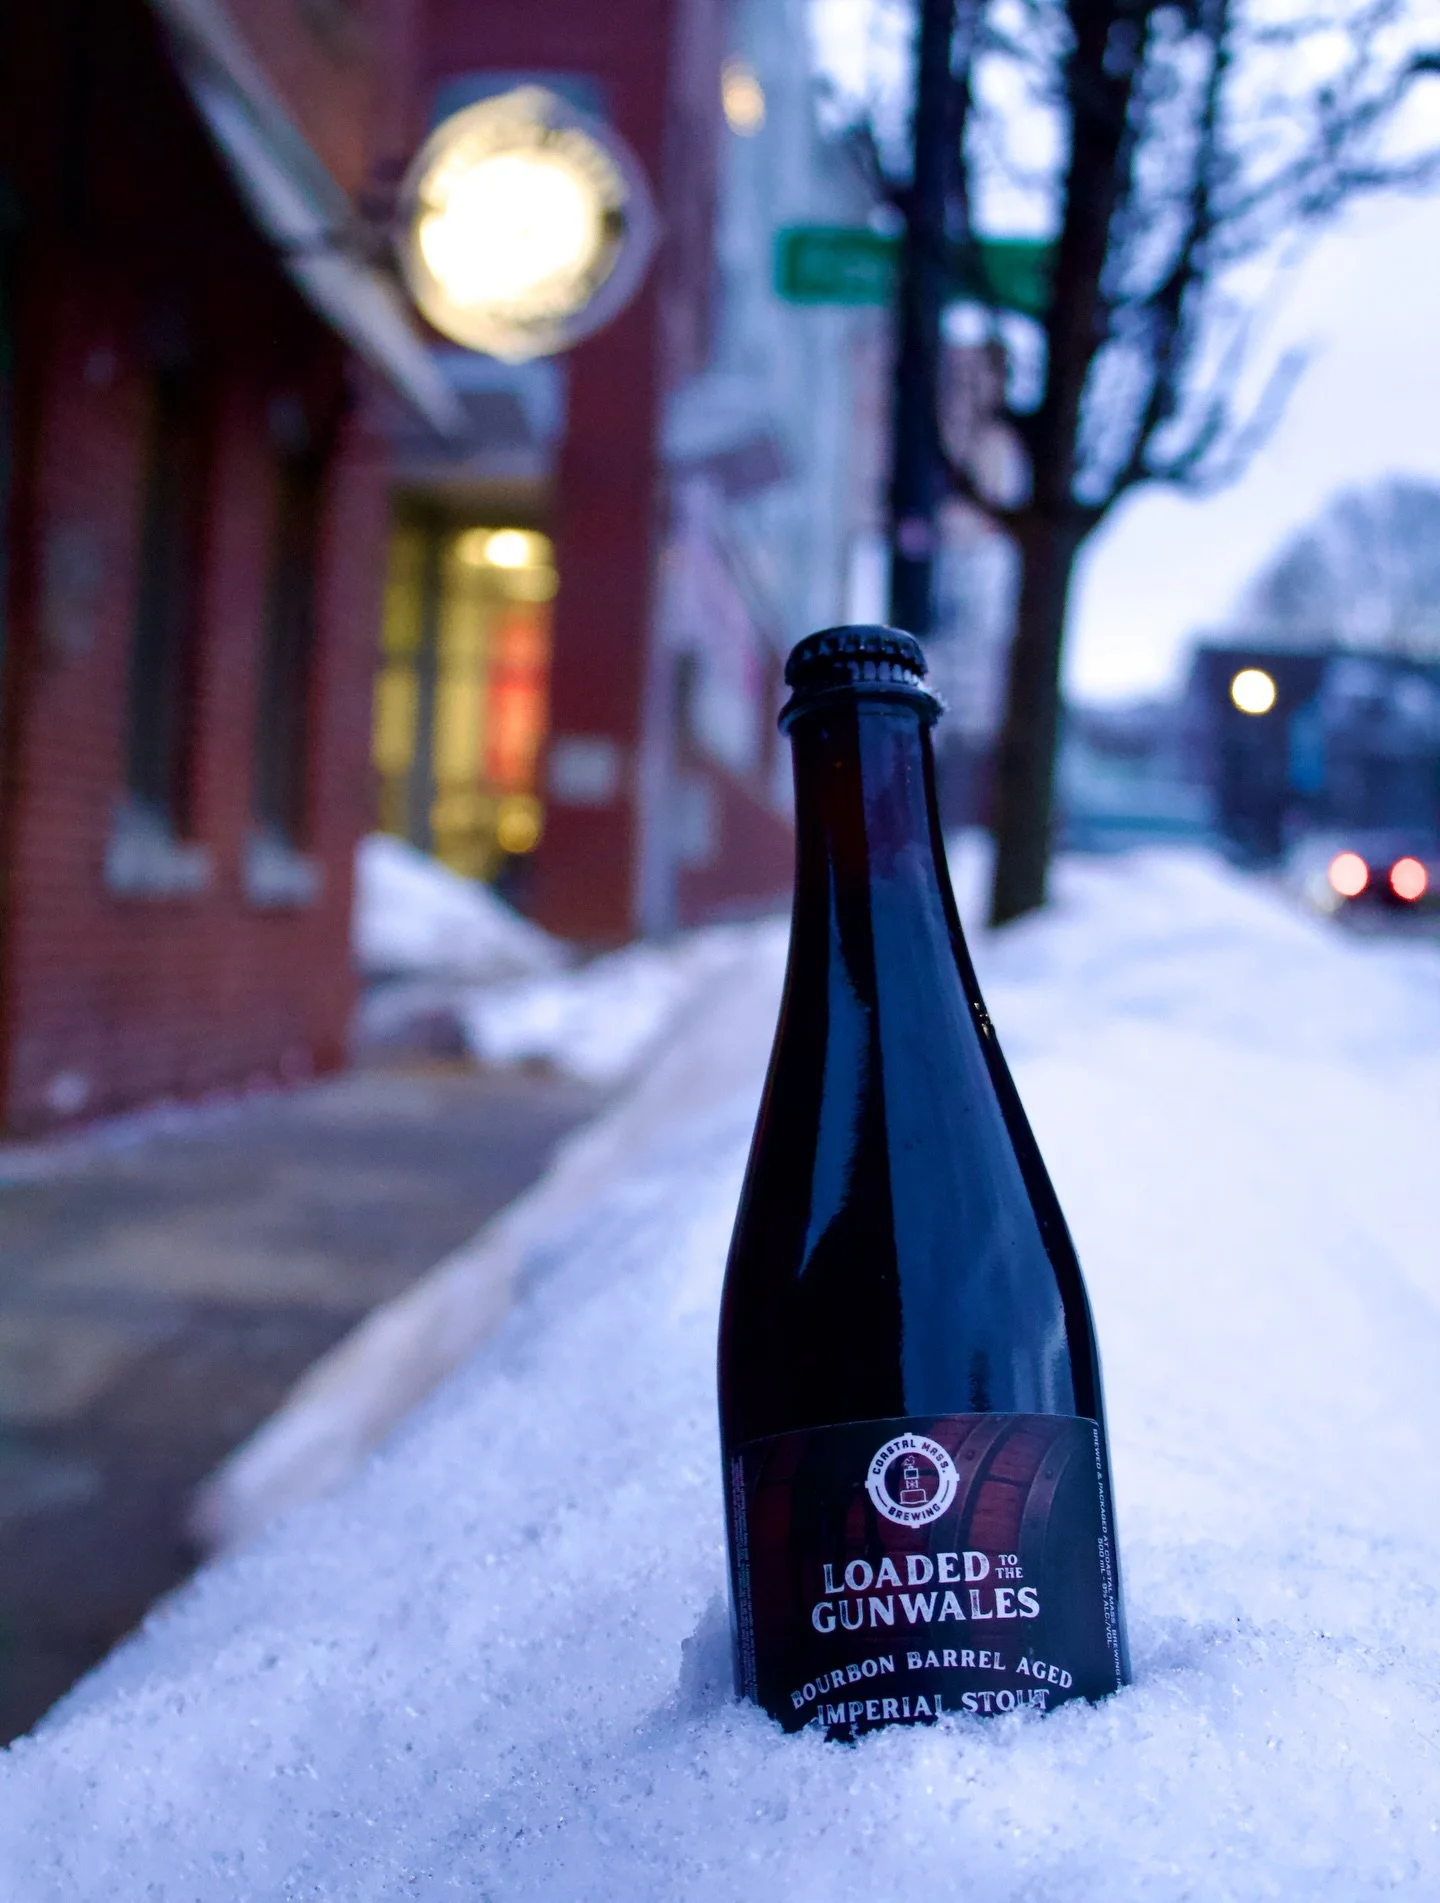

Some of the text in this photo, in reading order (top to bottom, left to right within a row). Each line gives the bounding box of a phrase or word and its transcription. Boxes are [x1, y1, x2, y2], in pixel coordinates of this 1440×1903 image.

[872, 1439, 949, 1475] COASTAL MASS.
[888, 1503, 941, 1521] BREWING
[1093, 1428, 1101, 1469] BREWED
[1098, 1482, 1107, 1533] PACKAGED
[1104, 1550, 1112, 1592] COASTAL
[1111, 1630, 1121, 1676] BREWING
[1097, 1538, 1105, 1558] 500
[823, 1551, 1018, 1594] LOADED TO
[995, 1567, 1023, 1579] THE
[1099, 1559, 1106, 1574] mL
[811, 1586, 1041, 1633] GUNWALES
[790, 1649, 1073, 1710] BOURBON BARREL AGED
[961, 1689, 1050, 1714] STOUT
